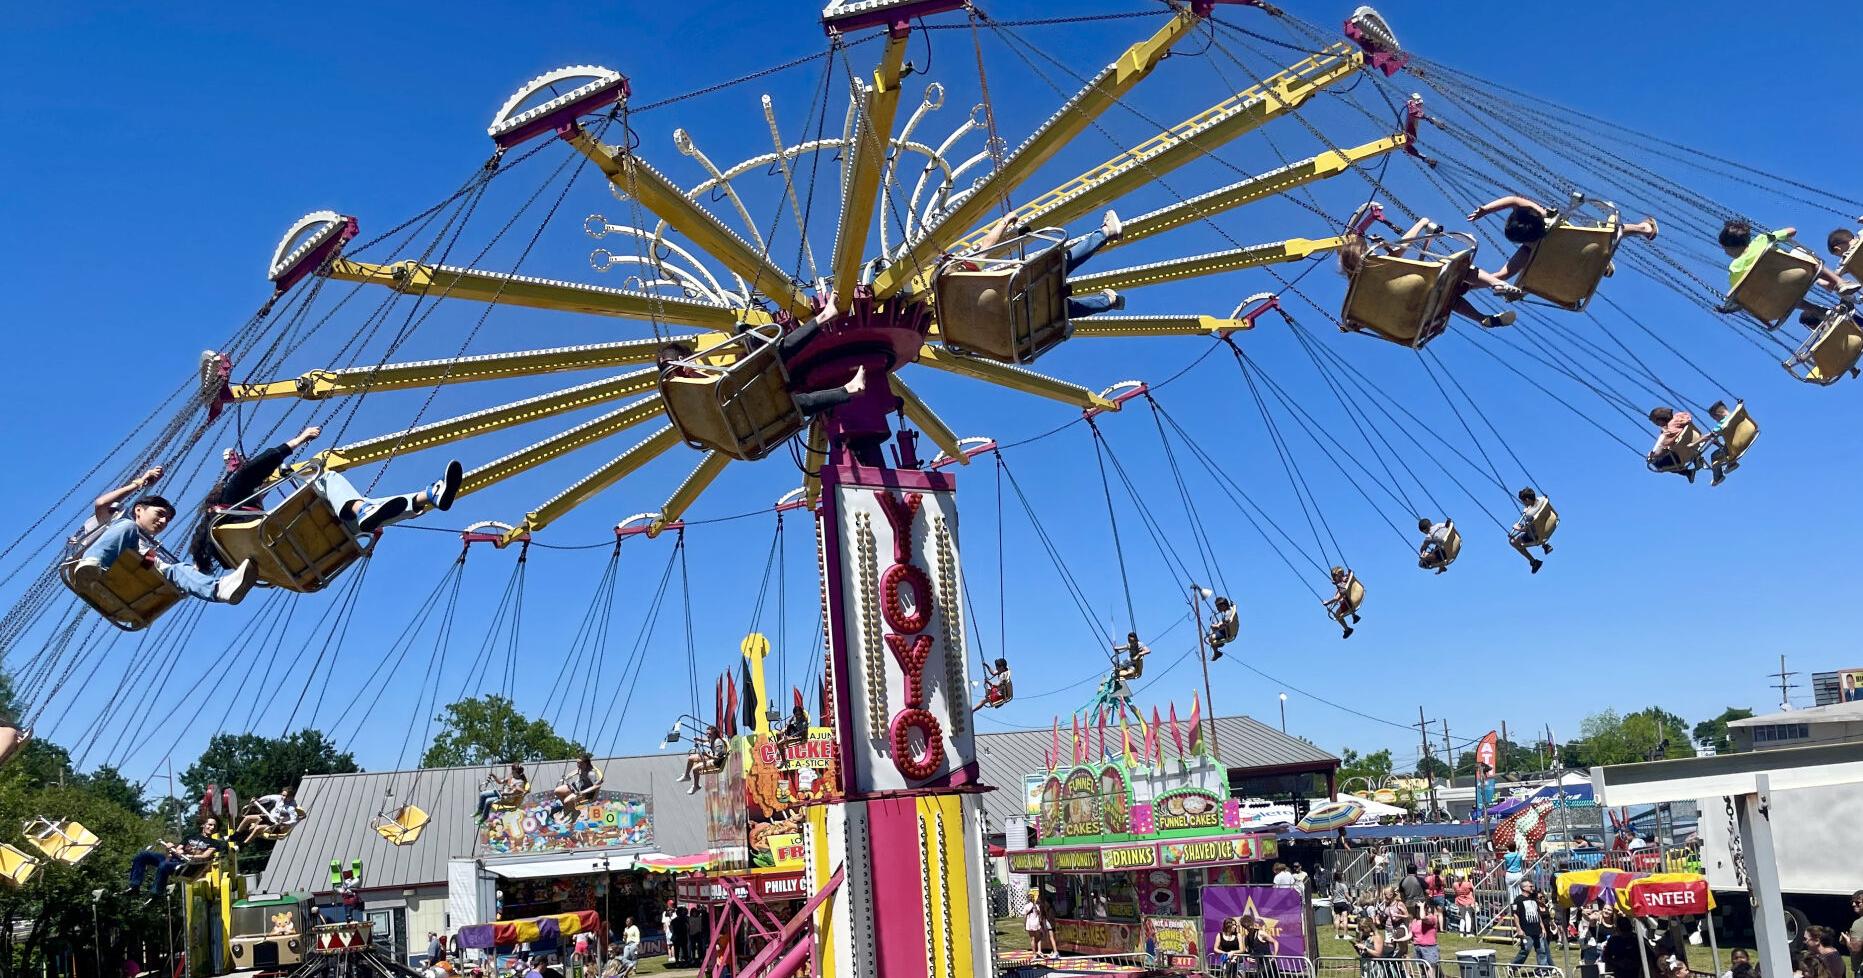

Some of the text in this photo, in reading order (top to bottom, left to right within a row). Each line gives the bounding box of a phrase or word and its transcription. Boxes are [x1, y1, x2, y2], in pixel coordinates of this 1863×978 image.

[808, 732, 832, 740] AJUN
[784, 759, 829, 769] N-A-STICK
[1068, 777, 1095, 794] FUNNEL
[503, 807, 551, 840] TOY
[1159, 813, 1217, 828] FUNNEL CAKES
[1066, 822, 1099, 835] CAKES
[1111, 847, 1153, 866] DRINKS
[1183, 841, 1233, 861] SHAVED ICE
[765, 879, 798, 894] PHILLY
[1643, 890, 1696, 907] ENTER
[1172, 956, 1192, 966] EXIT
